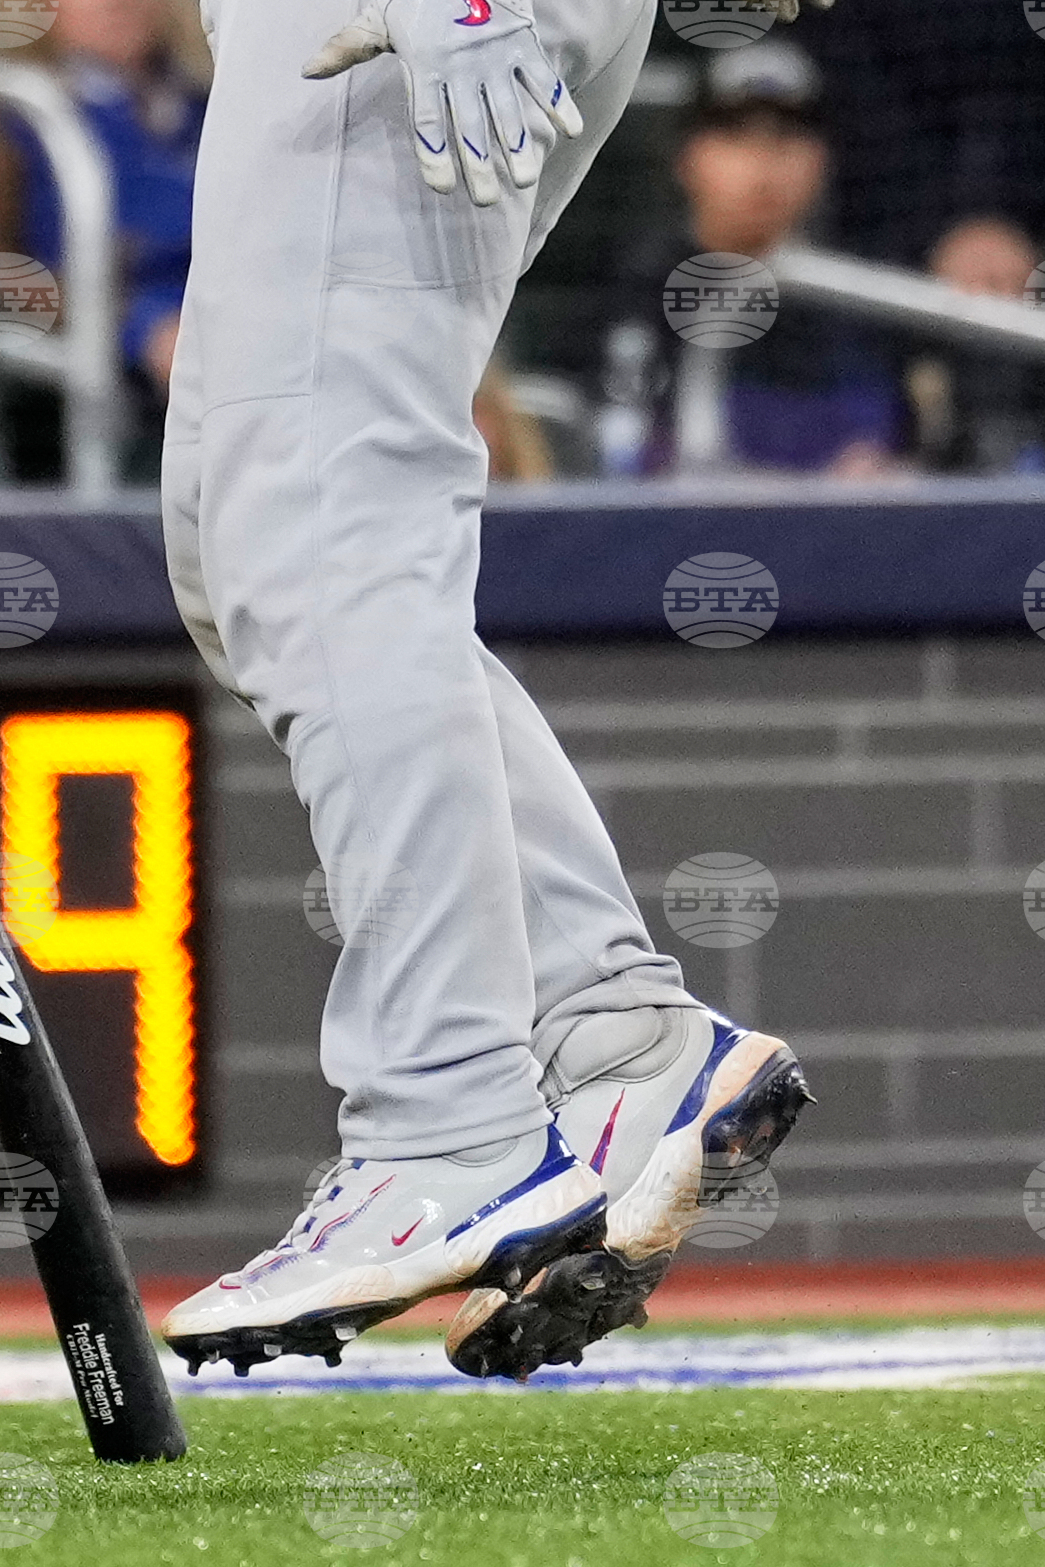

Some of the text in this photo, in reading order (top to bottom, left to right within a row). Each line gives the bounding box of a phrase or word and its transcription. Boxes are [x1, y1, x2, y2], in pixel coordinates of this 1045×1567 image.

[73, 1322, 116, 1426] Freddie Freeman
[94, 1333, 125, 1407] Handcrafted For
